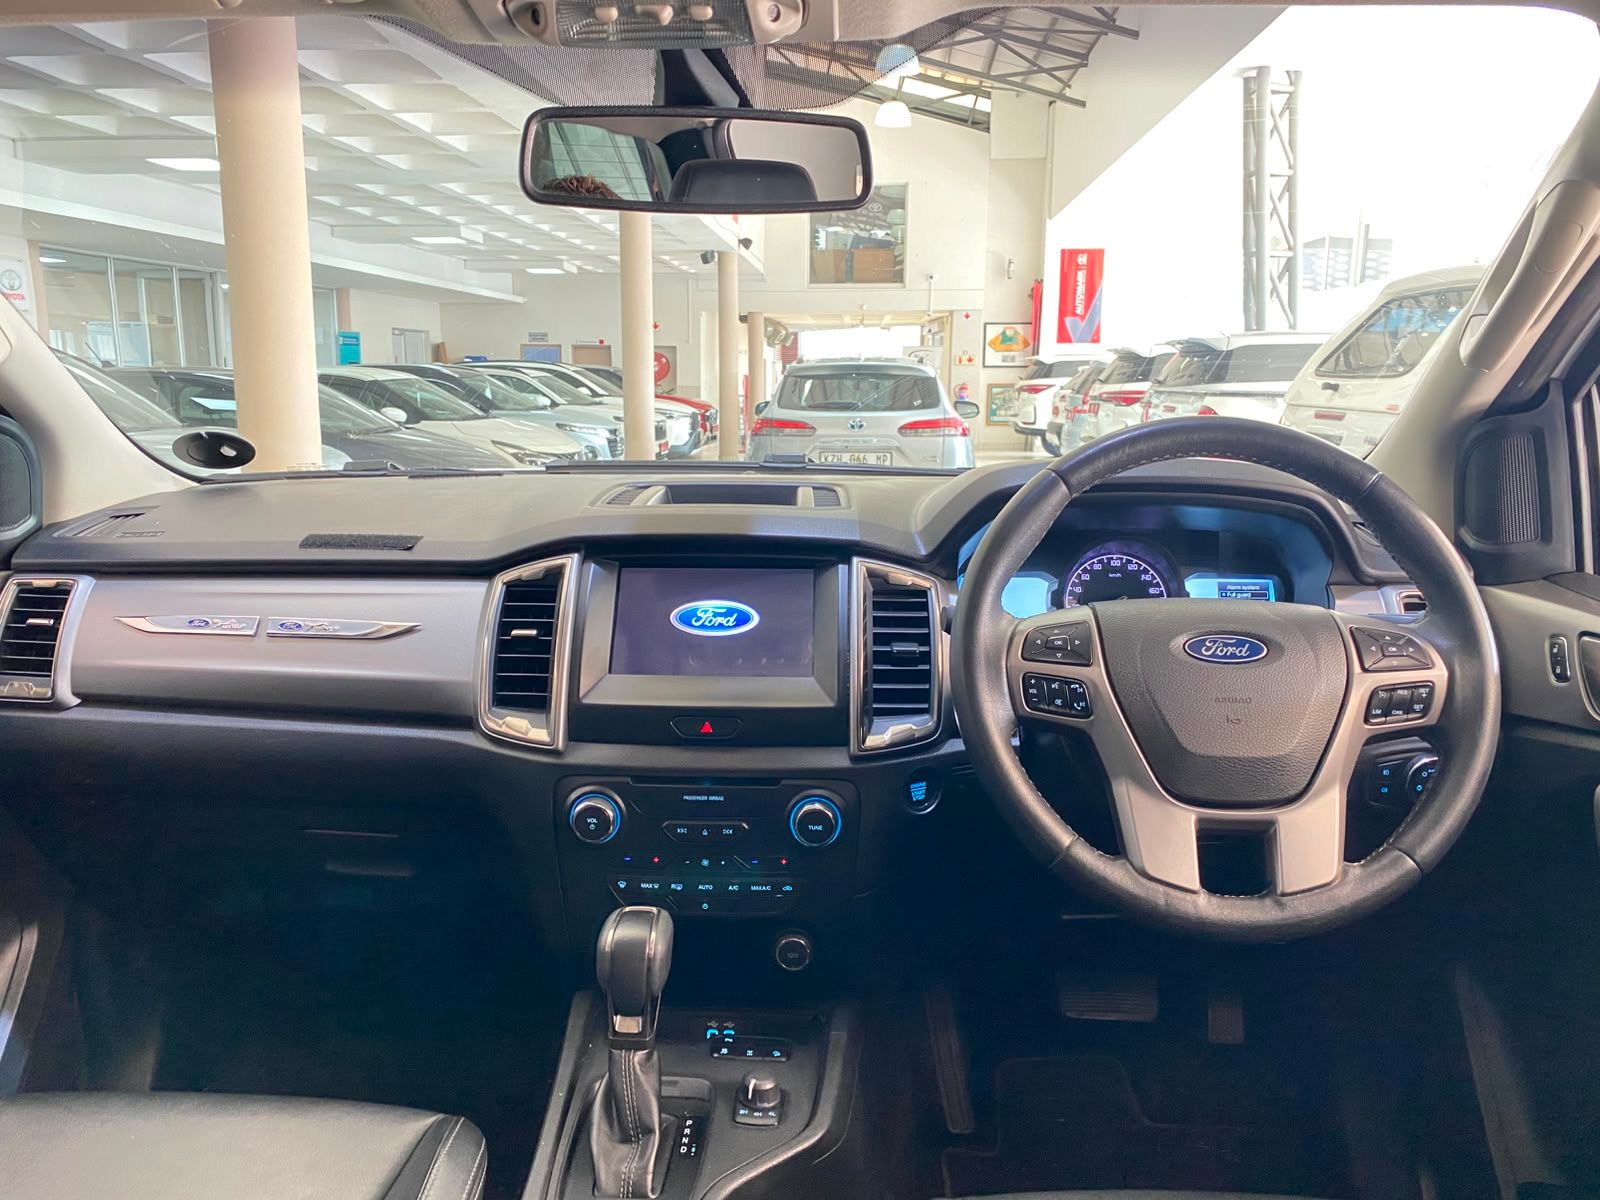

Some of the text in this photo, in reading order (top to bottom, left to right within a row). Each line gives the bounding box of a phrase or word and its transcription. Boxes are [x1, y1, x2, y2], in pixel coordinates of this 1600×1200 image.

[1075, 270, 1084, 315] AUTOMARK
[876, 455, 888, 464] MP
[691, 607, 738, 627] Ford
[1201, 638, 1250, 656] Ford
